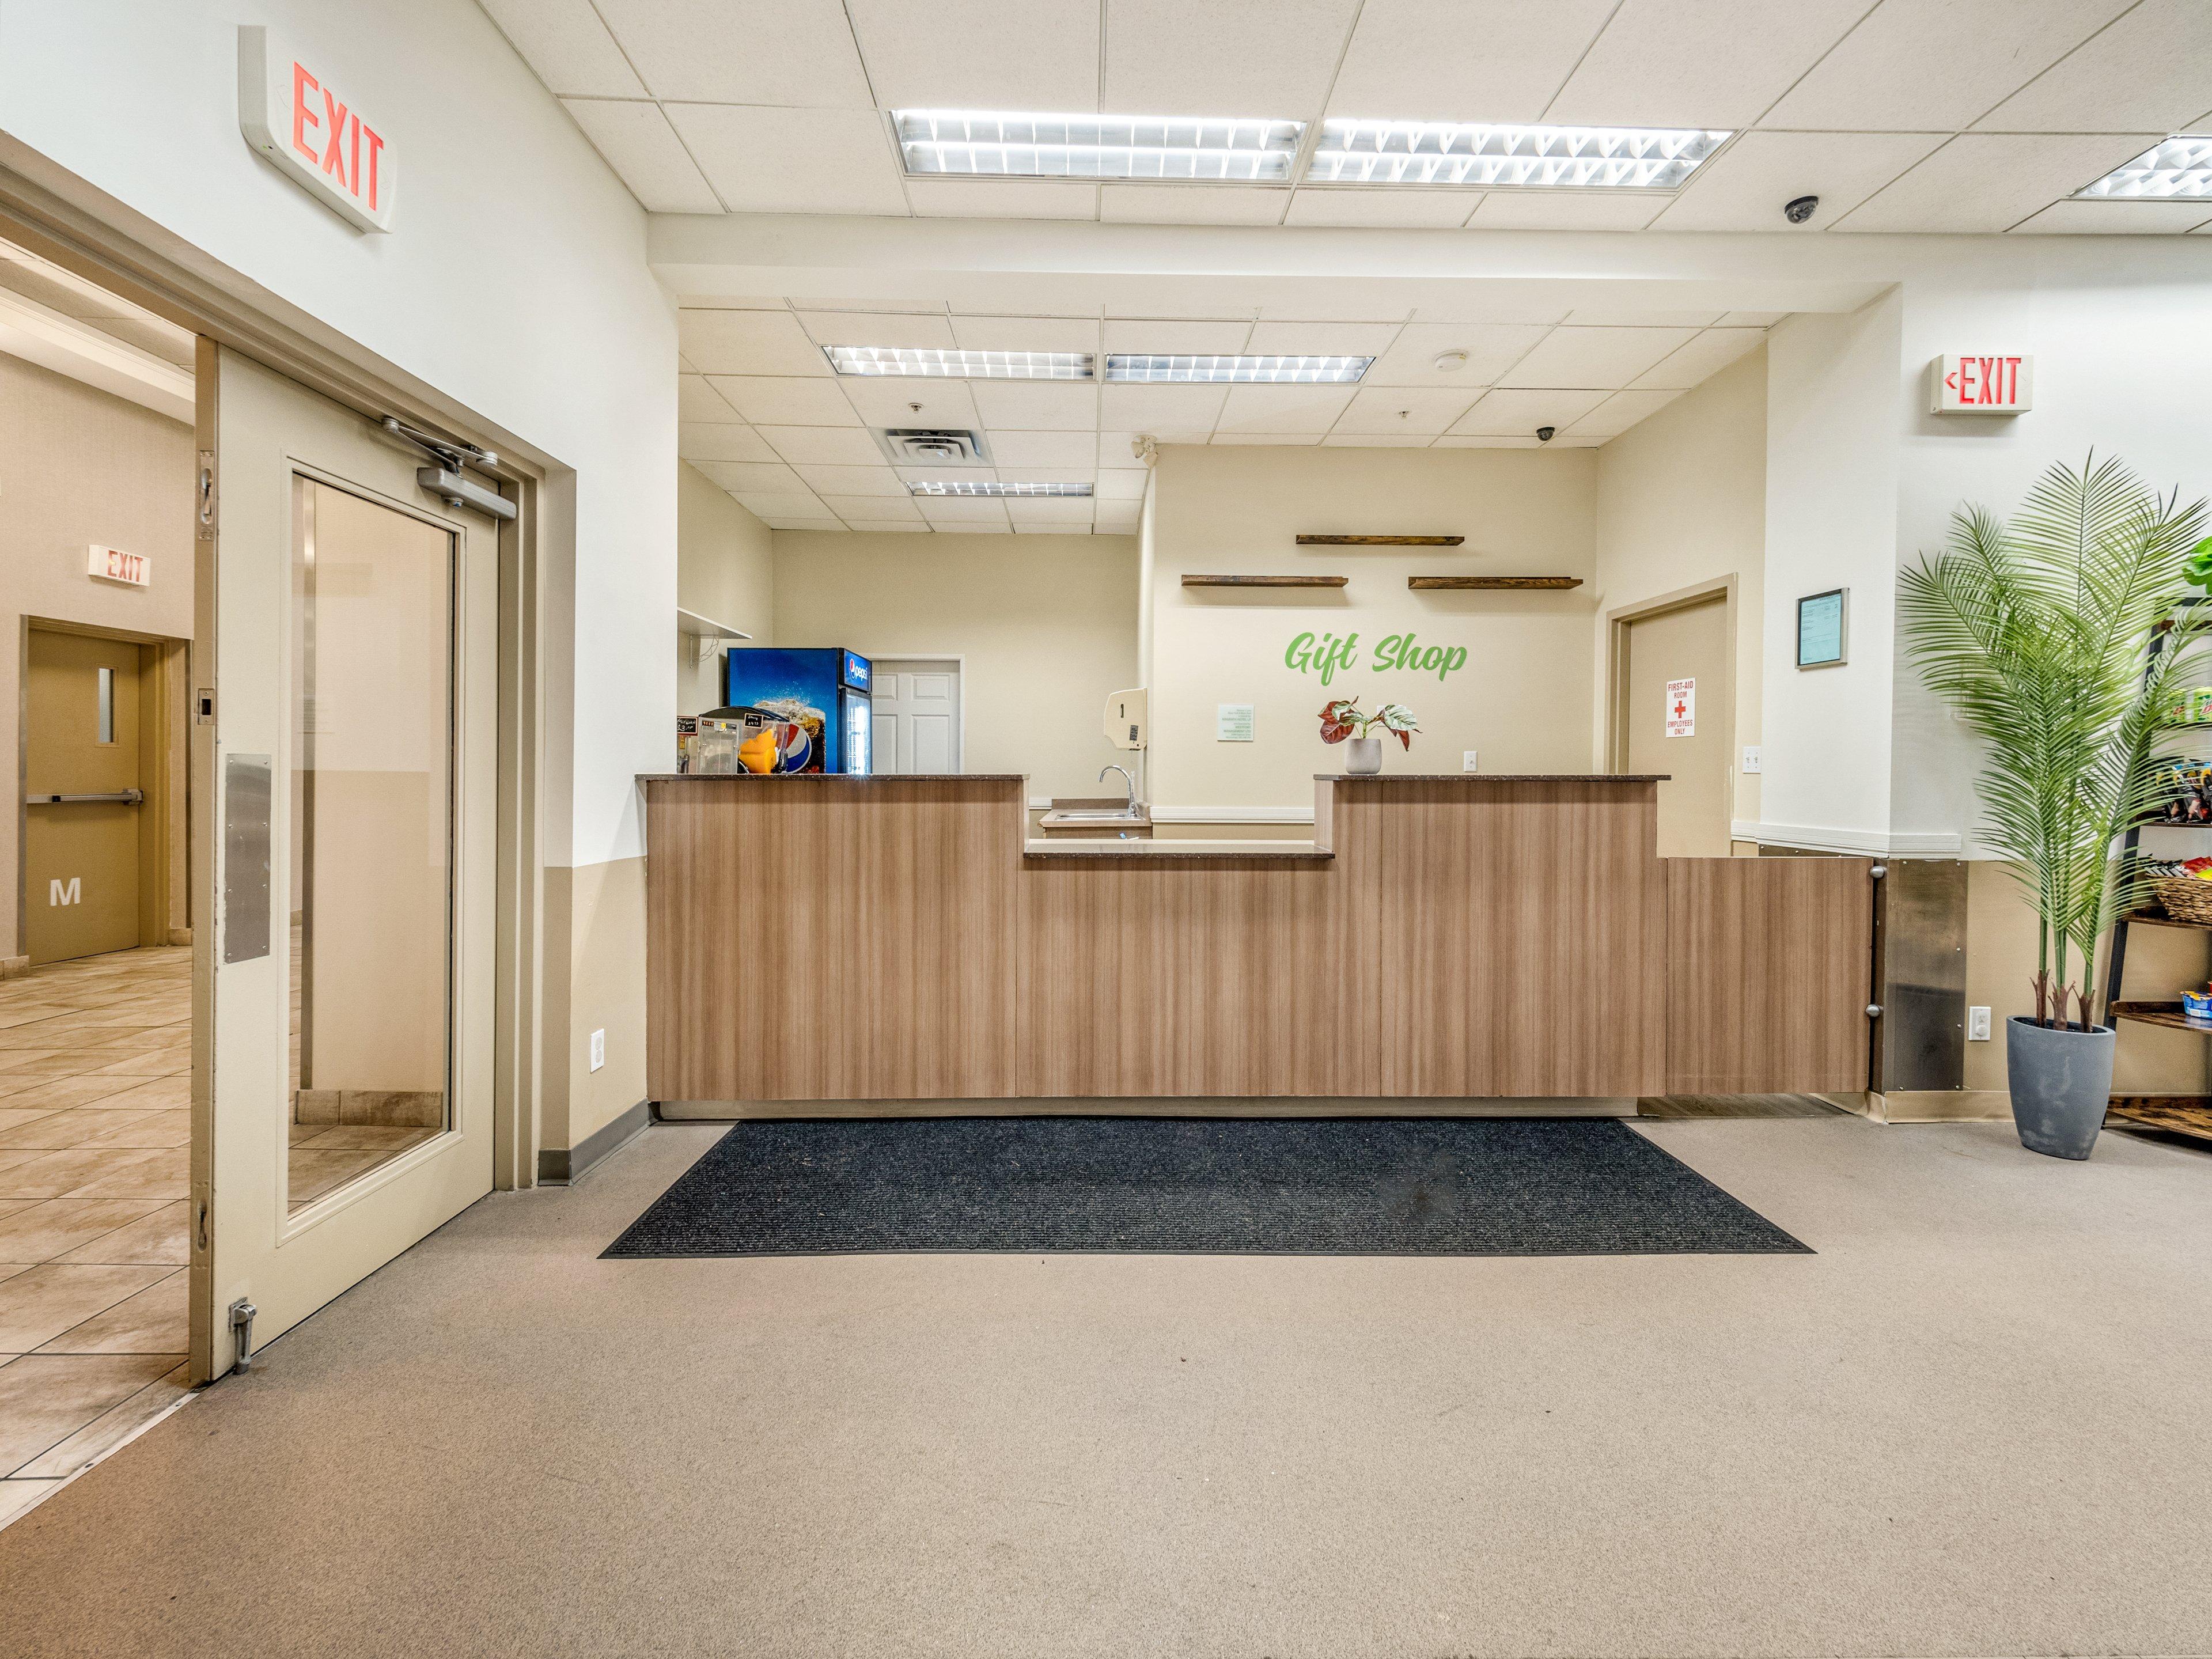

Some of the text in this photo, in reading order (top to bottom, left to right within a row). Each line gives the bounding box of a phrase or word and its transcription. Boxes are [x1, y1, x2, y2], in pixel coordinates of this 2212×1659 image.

[293, 60, 384, 212] EXIT
[1959, 357, 2022, 404] EXIT
[107, 550, 143, 582] EXIT
[854, 665, 868, 681] pepsi
[1284, 631, 1468, 687] Gift Shop
[1668, 680, 1694, 691] FIRST-AID
[1667, 719, 1693, 728] EMPLOYEES
[50, 877, 81, 907] M
